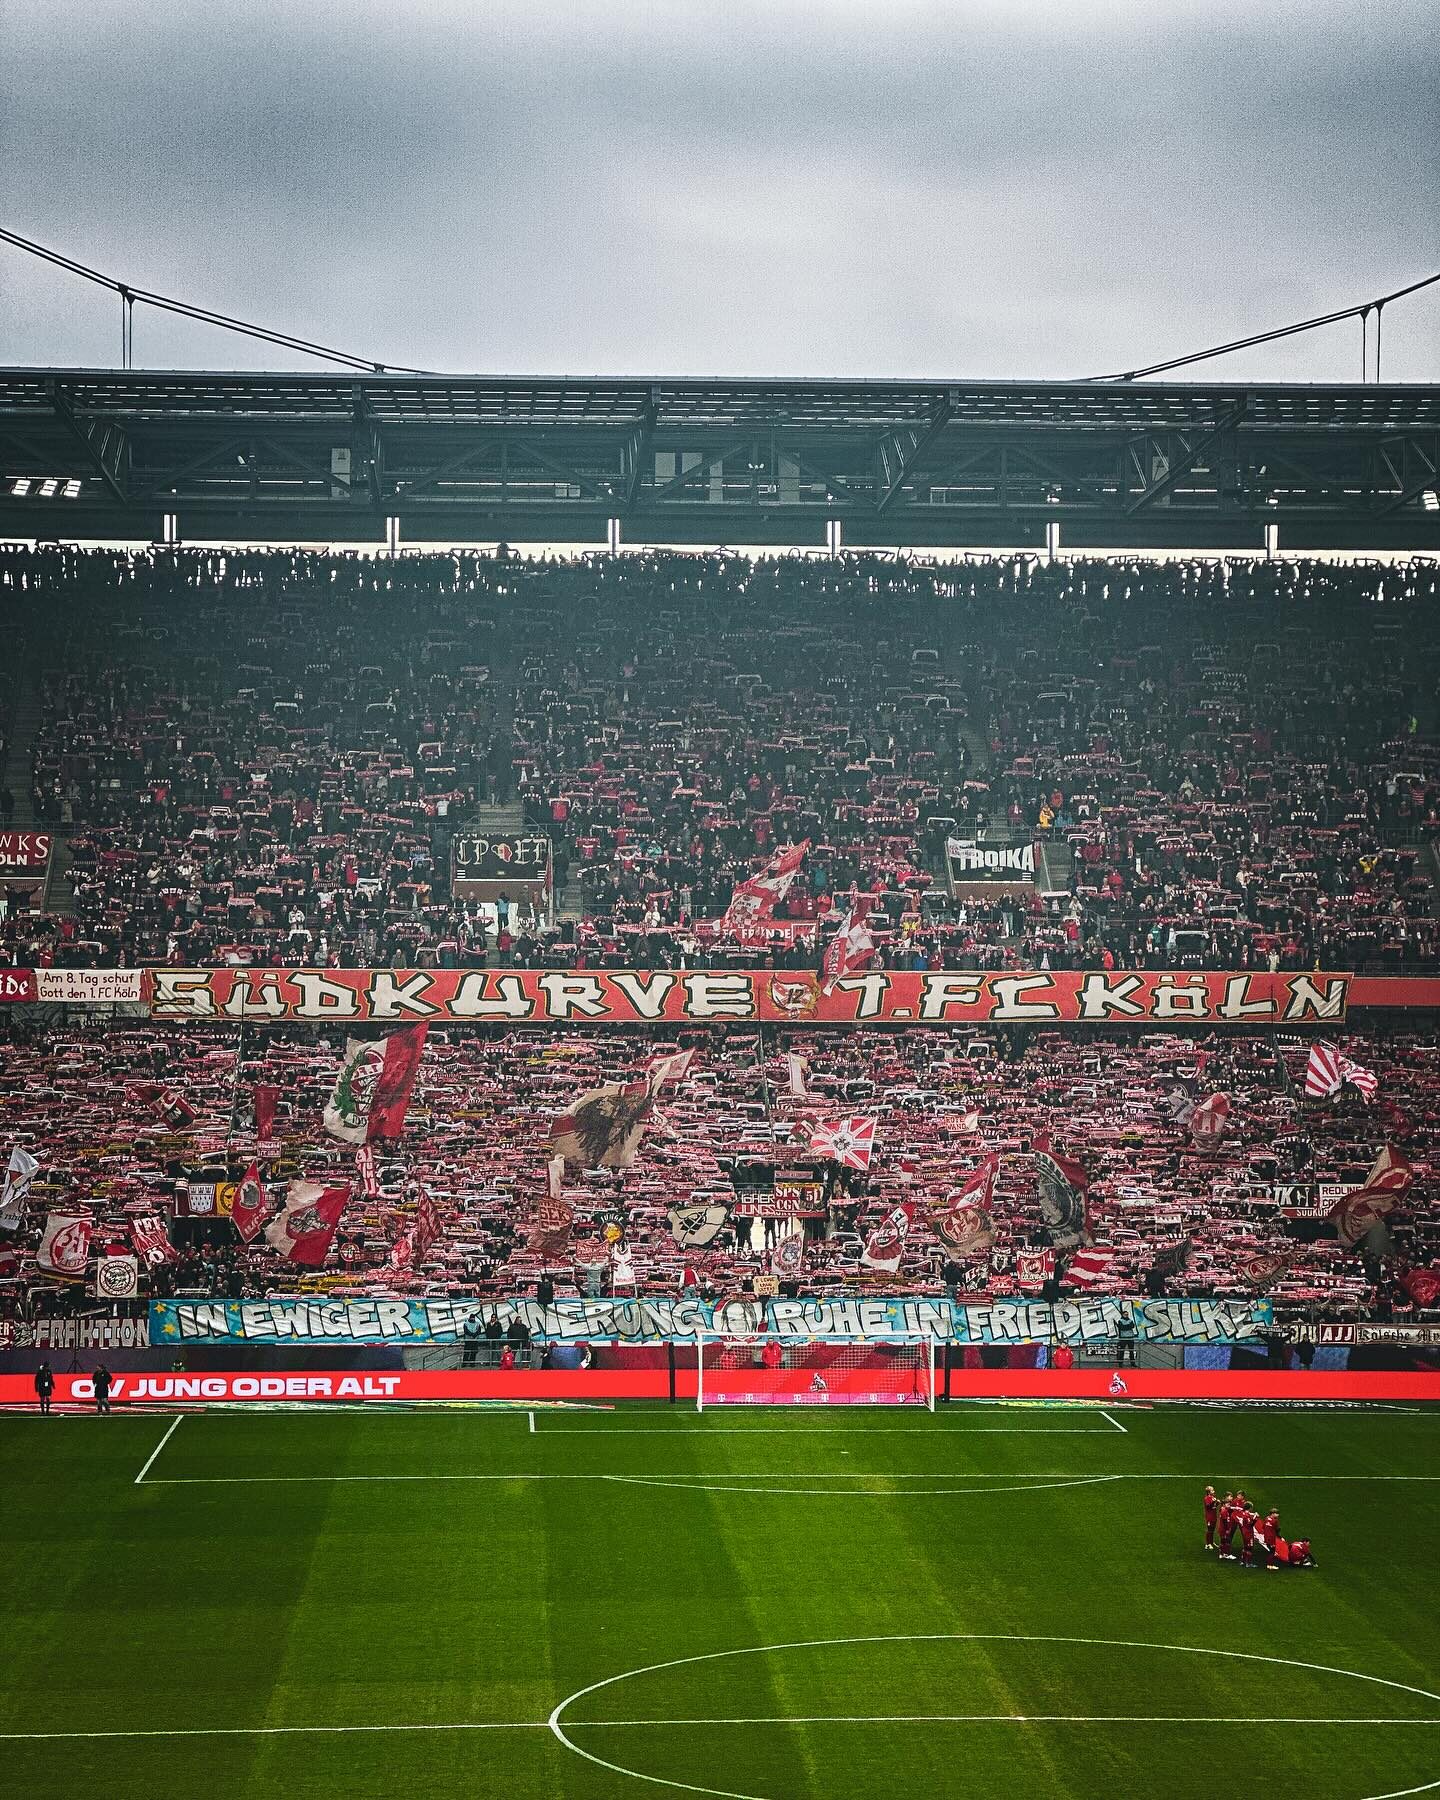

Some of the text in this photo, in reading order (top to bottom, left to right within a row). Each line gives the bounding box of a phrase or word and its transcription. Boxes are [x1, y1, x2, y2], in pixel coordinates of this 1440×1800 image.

[960, 843, 1035, 872] TROIKA
[40, 987, 63, 998] Gott
[67, 987, 86, 998] den
[98, 987, 111, 998] FC
[43, 972, 134, 986] Am 8. Tag schuf
[152, 971, 755, 1018] SÜDKURVE
[1076, 973, 1347, 1019] KÖLN
[735, 1204, 776, 1215] JUNGS
[36, 1319, 150, 1348] FRAKTION
[177, 1303, 230, 1339] IN
[241, 1301, 413, 1339] EWIGER
[771, 1300, 896, 1338] RUHE
[904, 1300, 951, 1340] IN
[965, 1300, 1138, 1340] FRIEDEN
[1144, 1300, 1265, 1340] SILKE
[129, 1378, 227, 1398] JUNG
[232, 1377, 334, 1397] ODER
[335, 1377, 401, 1396] ALT
